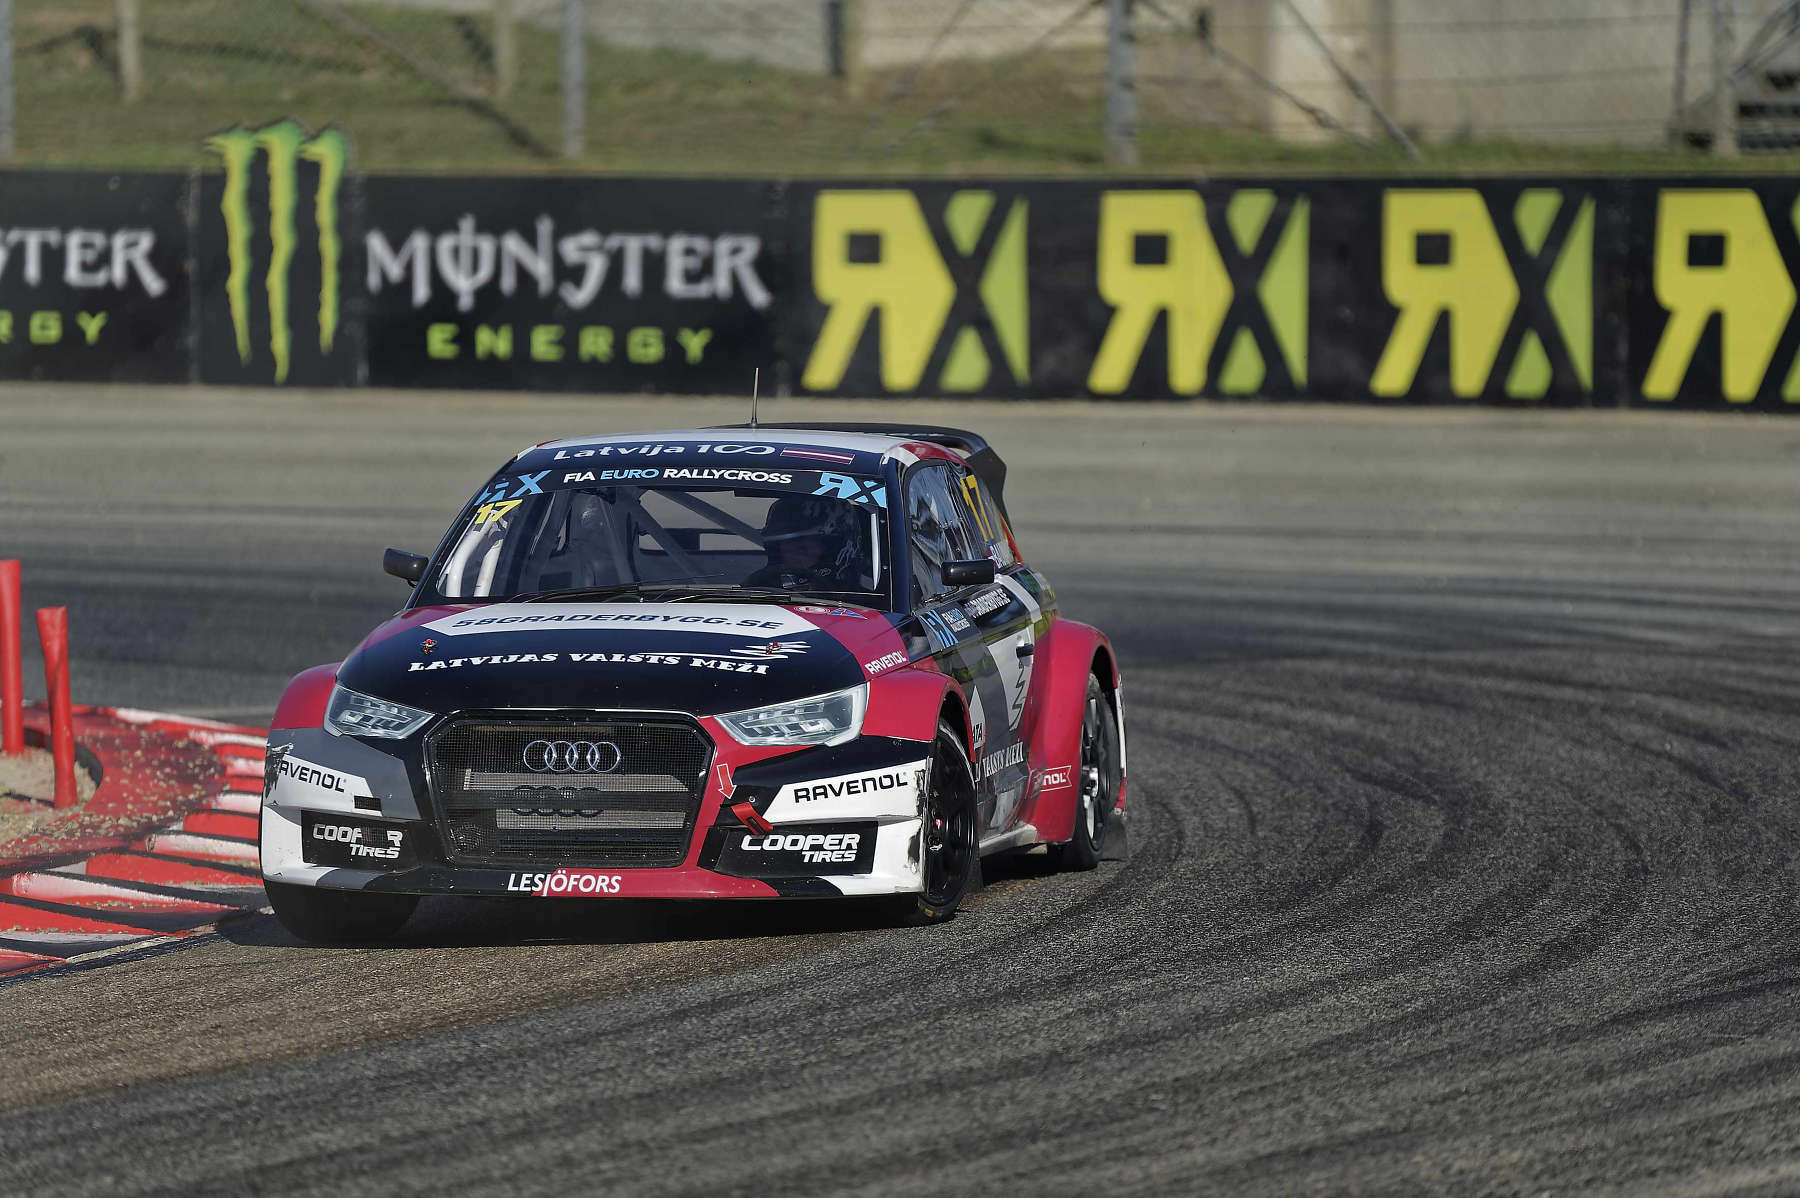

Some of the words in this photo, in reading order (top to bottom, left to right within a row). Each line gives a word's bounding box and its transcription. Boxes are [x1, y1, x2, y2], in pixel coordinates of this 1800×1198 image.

[0, 226, 168, 298] TER
[365, 213, 772, 311] MONSTER
[426, 322, 712, 364] ENERGY
[553, 444, 685, 461] Latvija
[563, 471, 596, 484] FIA
[600, 468, 660, 480] EURO
[662, 468, 793, 484] RALLYCROSS
[475, 499, 523, 524] 17
[408, 653, 559, 672] LATVIJAS
[569, 653, 681, 665] VALSTS
[689, 657, 770, 675] MEŽI
[864, 650, 907, 675] RAVENOL
[280, 760, 345, 793] AVENOL
[793, 772, 908, 803] RAVENOL
[312, 823, 403, 847] COOPR
[740, 833, 860, 851] COOPER
[349, 843, 401, 859] TIRES
[801, 850, 857, 863] TIRES
[507, 869, 622, 897] LESJÖFORS
